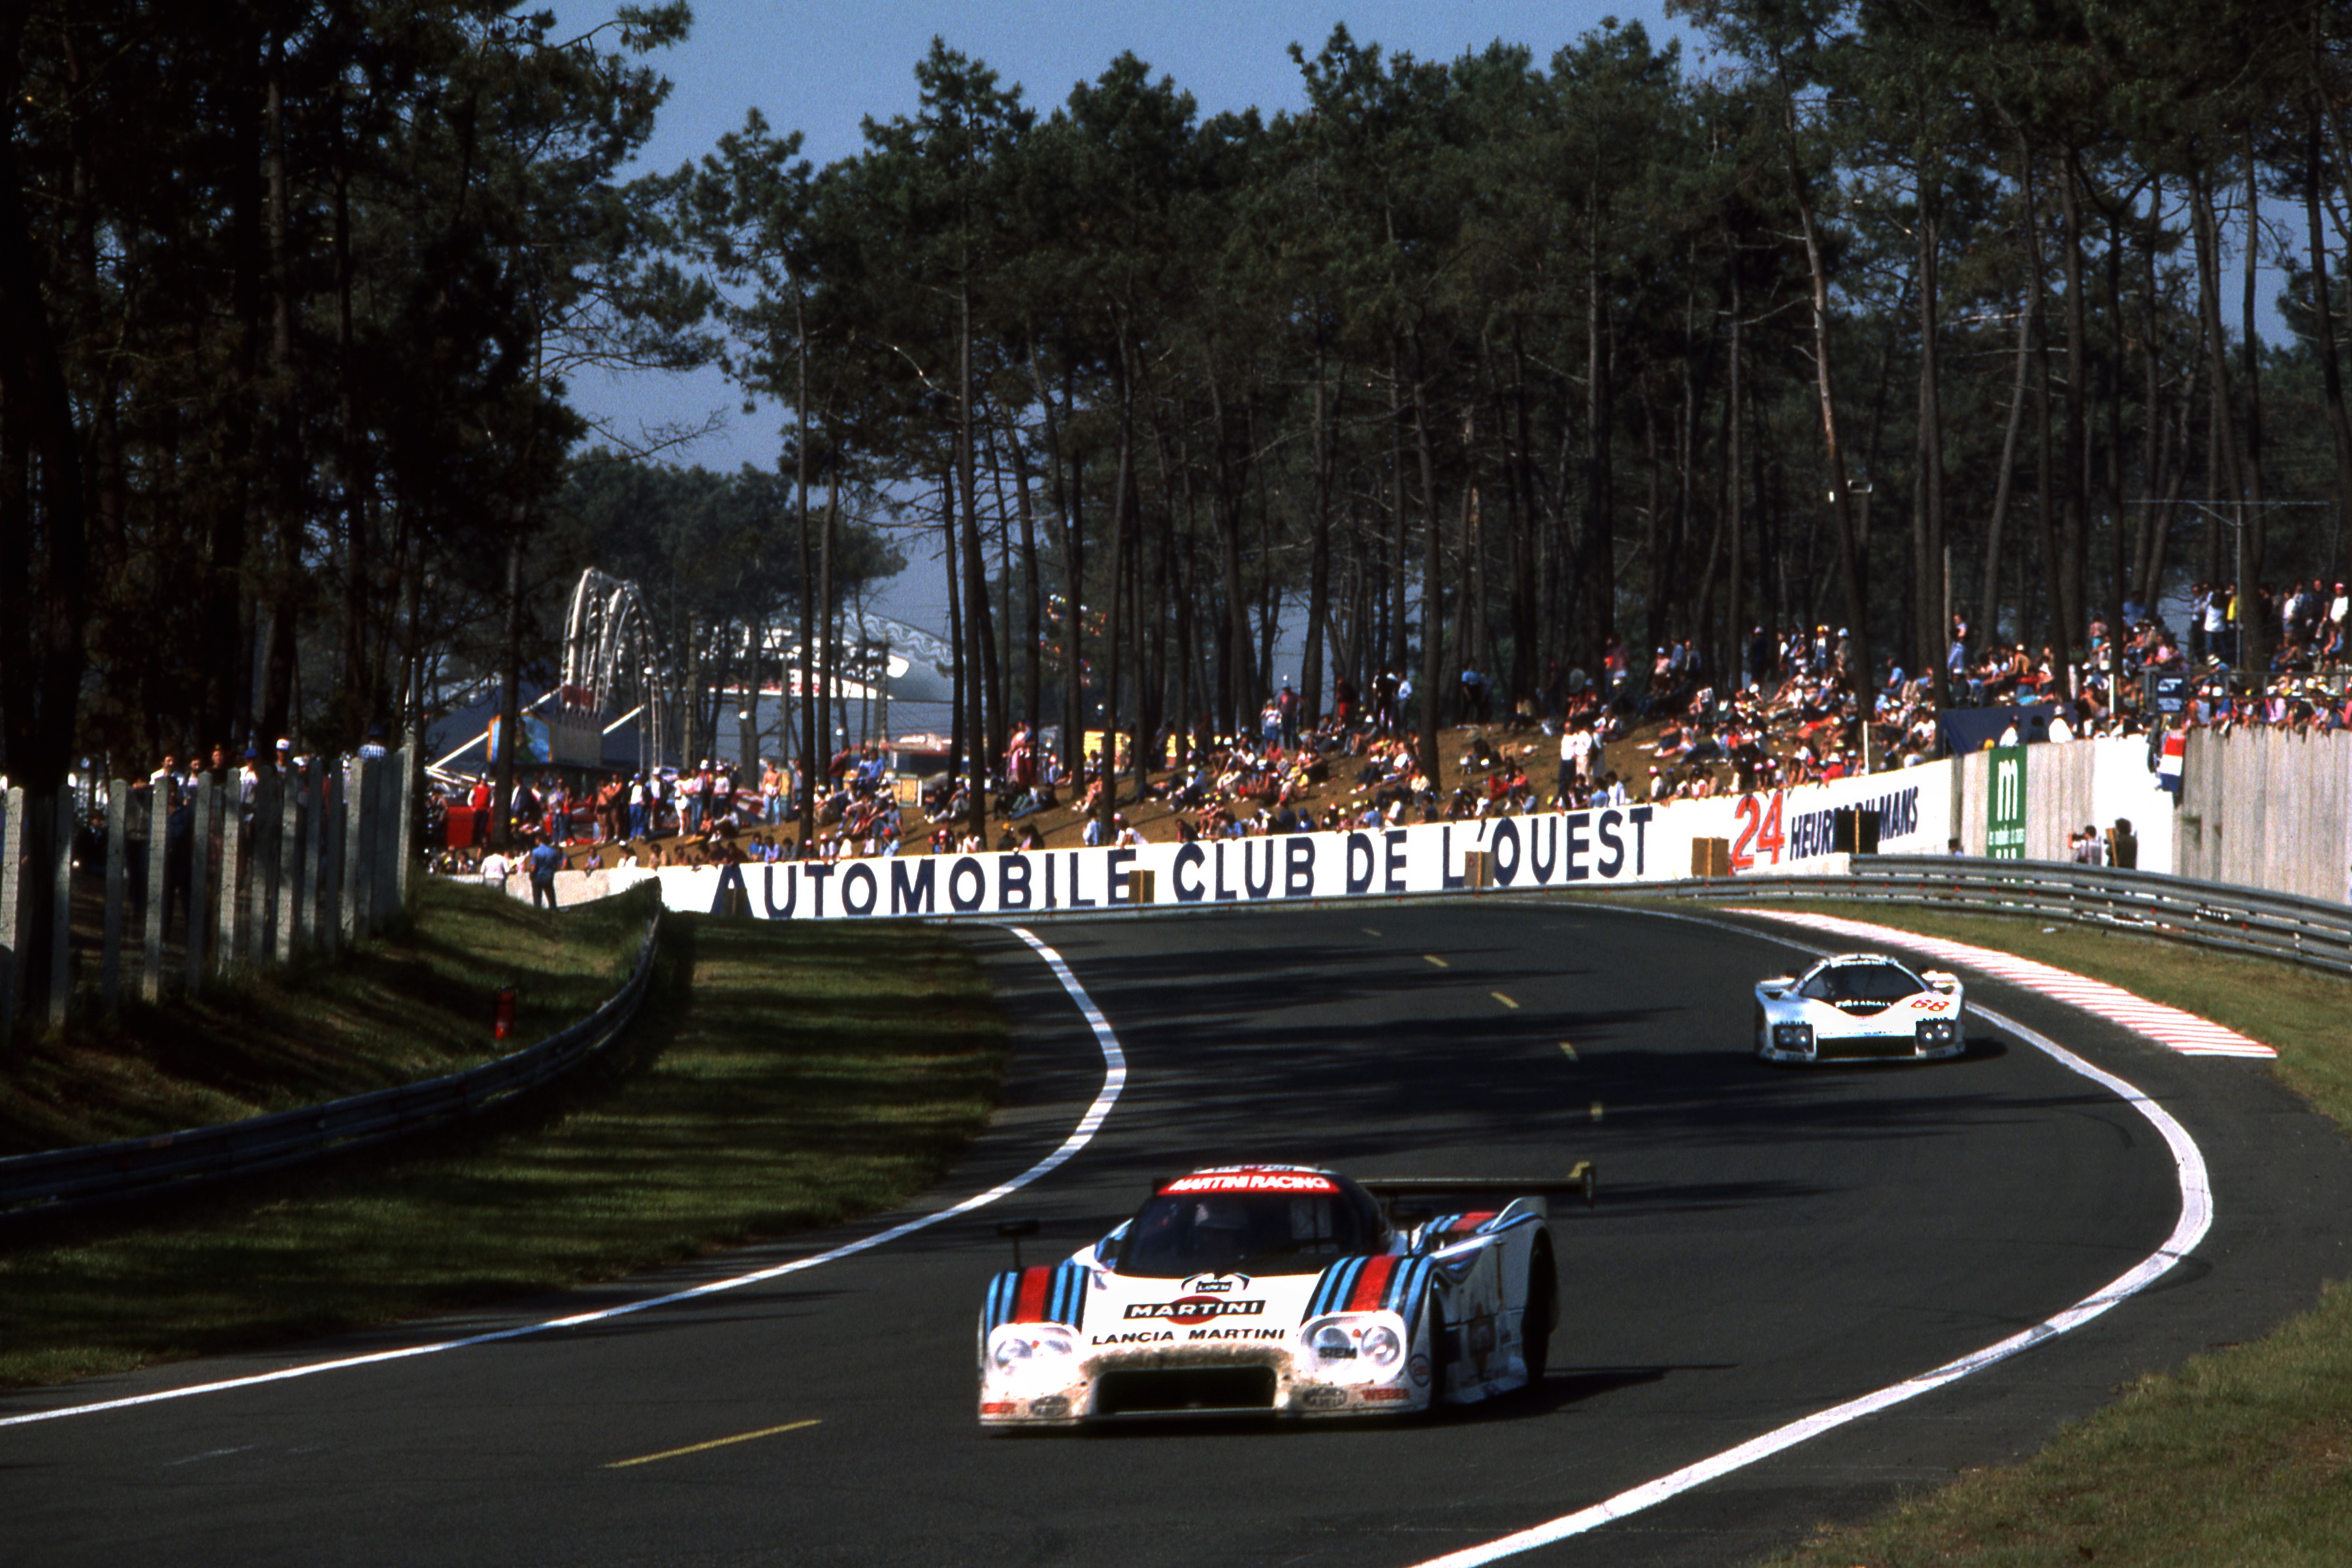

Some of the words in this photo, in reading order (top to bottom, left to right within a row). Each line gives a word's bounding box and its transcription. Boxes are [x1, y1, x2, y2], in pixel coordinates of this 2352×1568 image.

[1997, 759, 2018, 821] m
[1731, 789, 1785, 872] 24
[1789, 804, 1850, 861] HEUR
[1879, 785, 1919, 841] MANS
[710, 849, 1136, 919] AUTOMOBILE
[1173, 836, 1315, 902] CLUB
[1347, 830, 1407, 894] DE
[1442, 806, 1652, 888] L'OUEST
[1911, 999, 1950, 1011] 68
[1169, 1175, 1249, 1191] MARTINI
[1249, 1175, 1330, 1189] RACING
[1130, 1302, 1259, 1317] MARTINI
[1092, 1330, 1174, 1345] LANCIA
[1188, 1328, 1285, 1340] MARTINI
